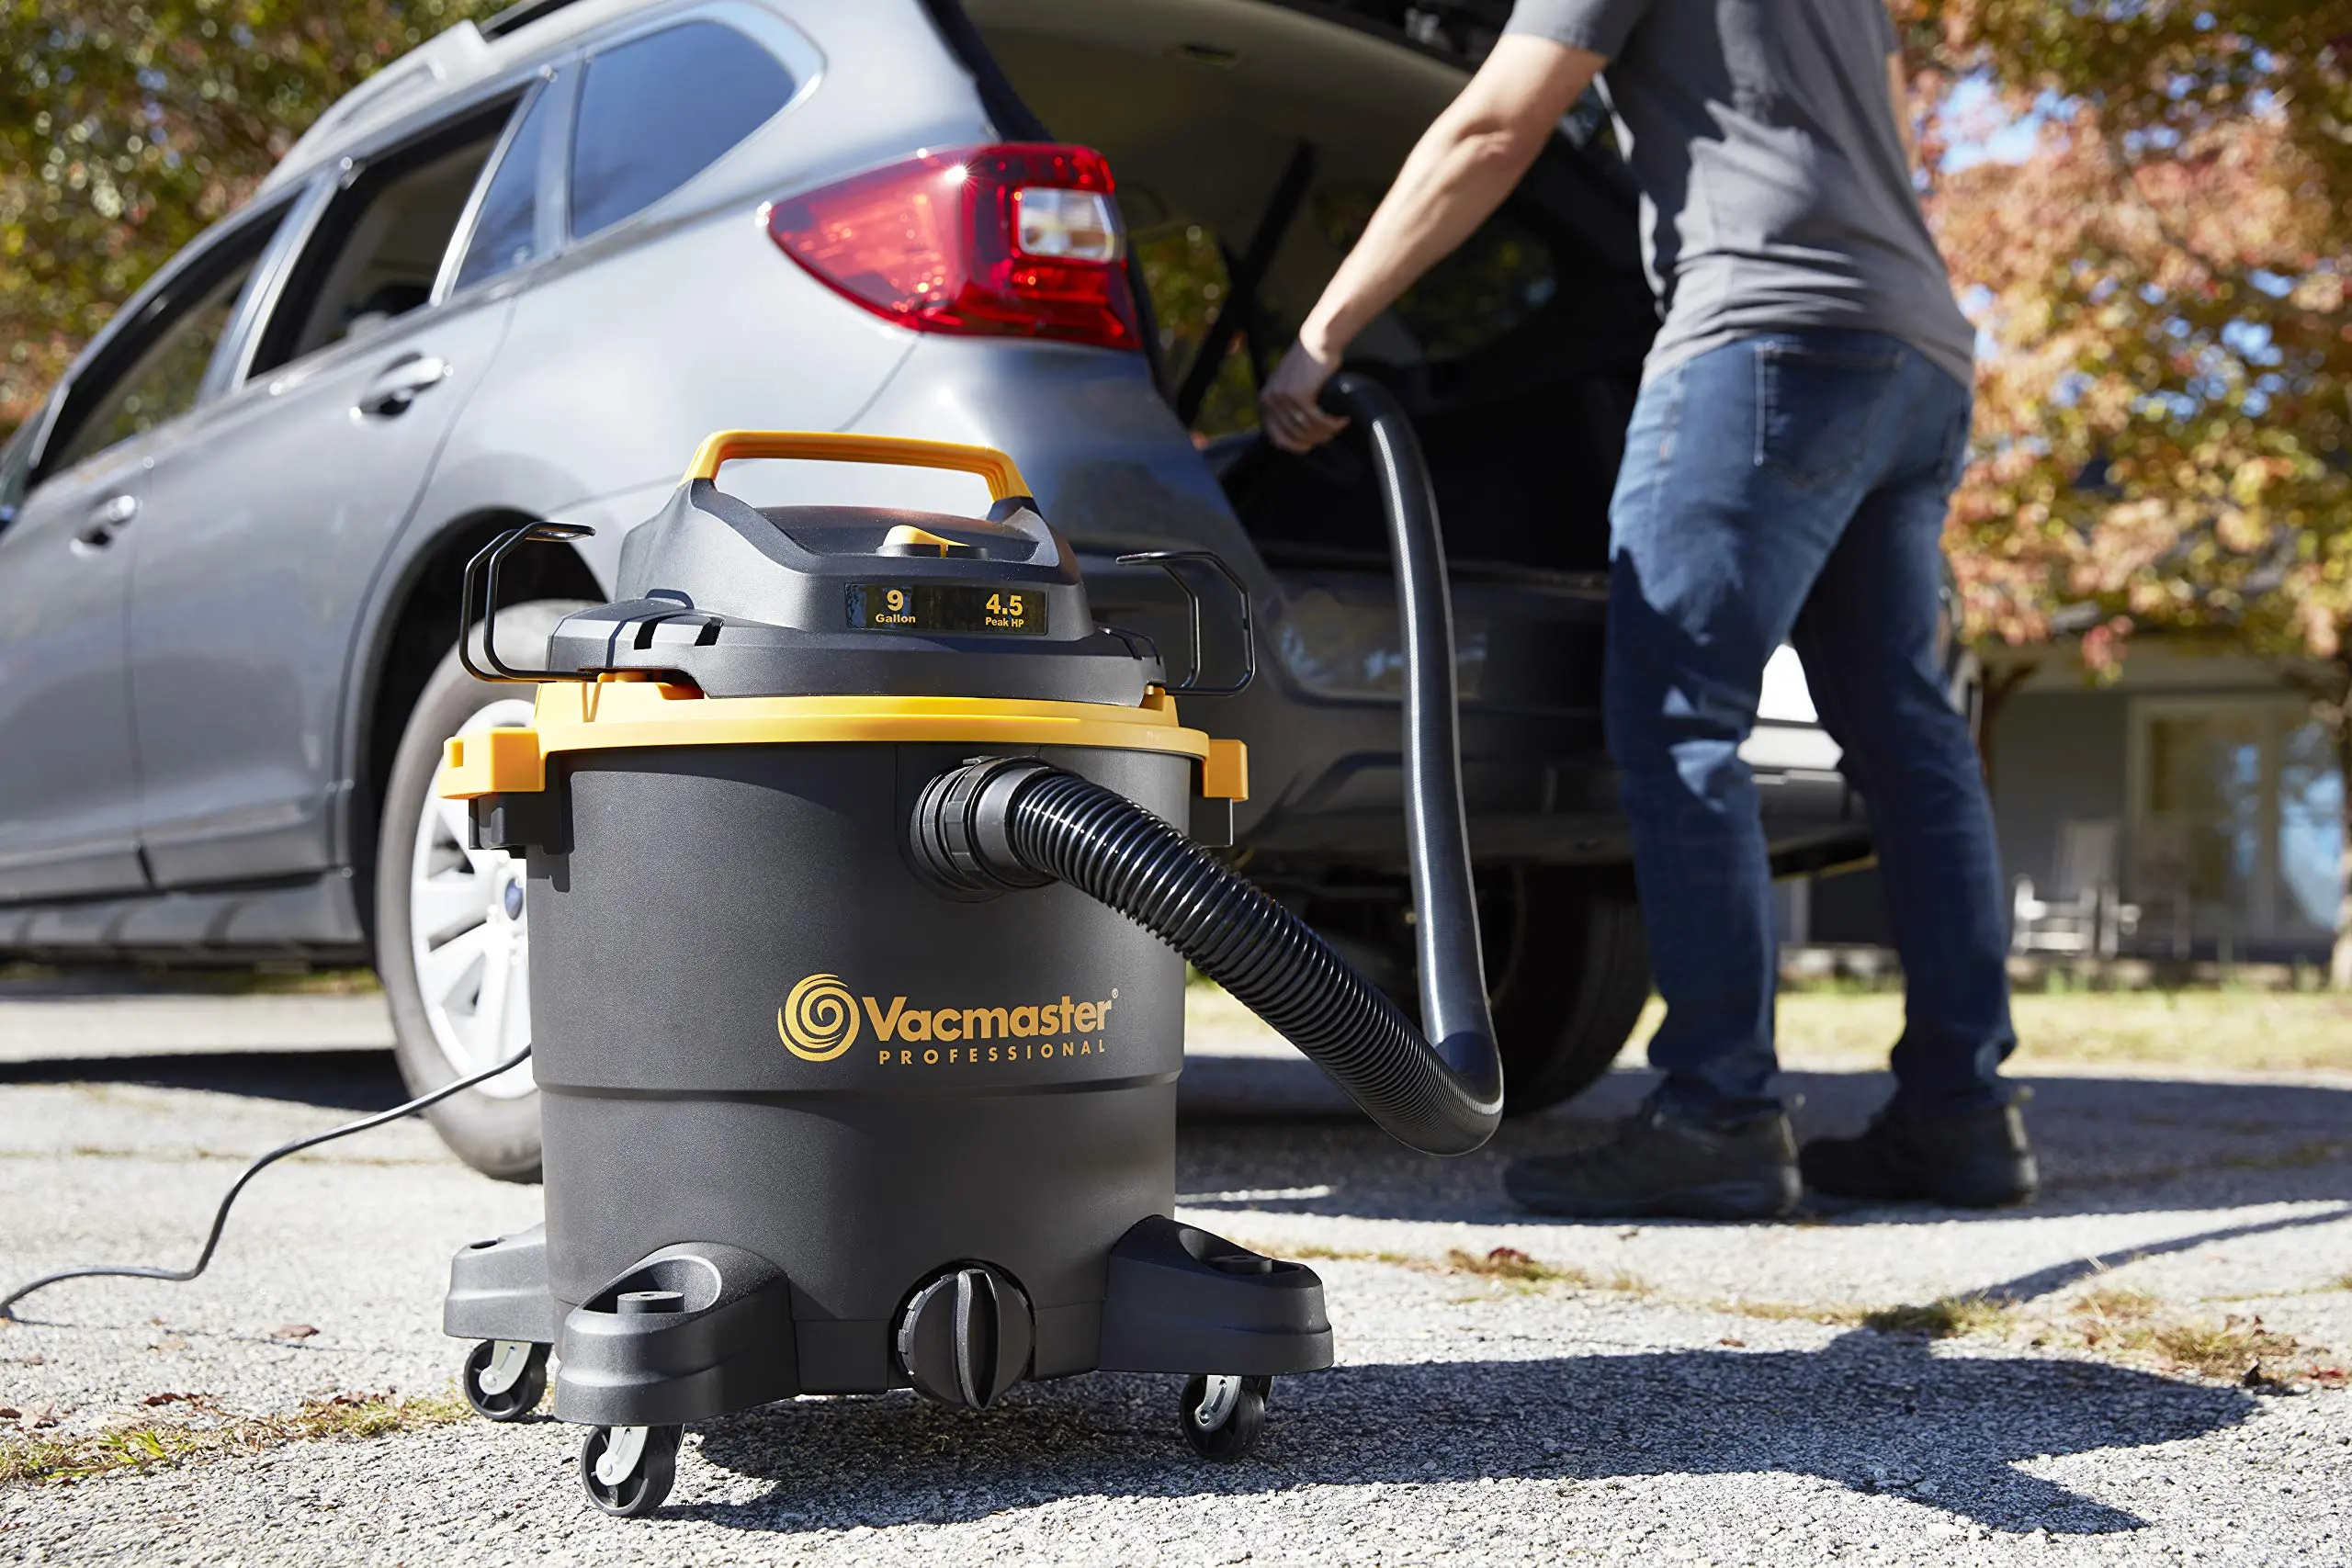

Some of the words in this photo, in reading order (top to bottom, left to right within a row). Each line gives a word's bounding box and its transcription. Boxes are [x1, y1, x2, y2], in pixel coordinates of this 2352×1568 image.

[887, 589, 904, 612] 9
[986, 593, 1023, 616] 4.5
[875, 614, 916, 624] Gallon
[985, 616, 1010, 627] Peak
[1011, 618, 1024, 628] HP
[878, 1038, 1105, 1066] PROFESSIONAL
